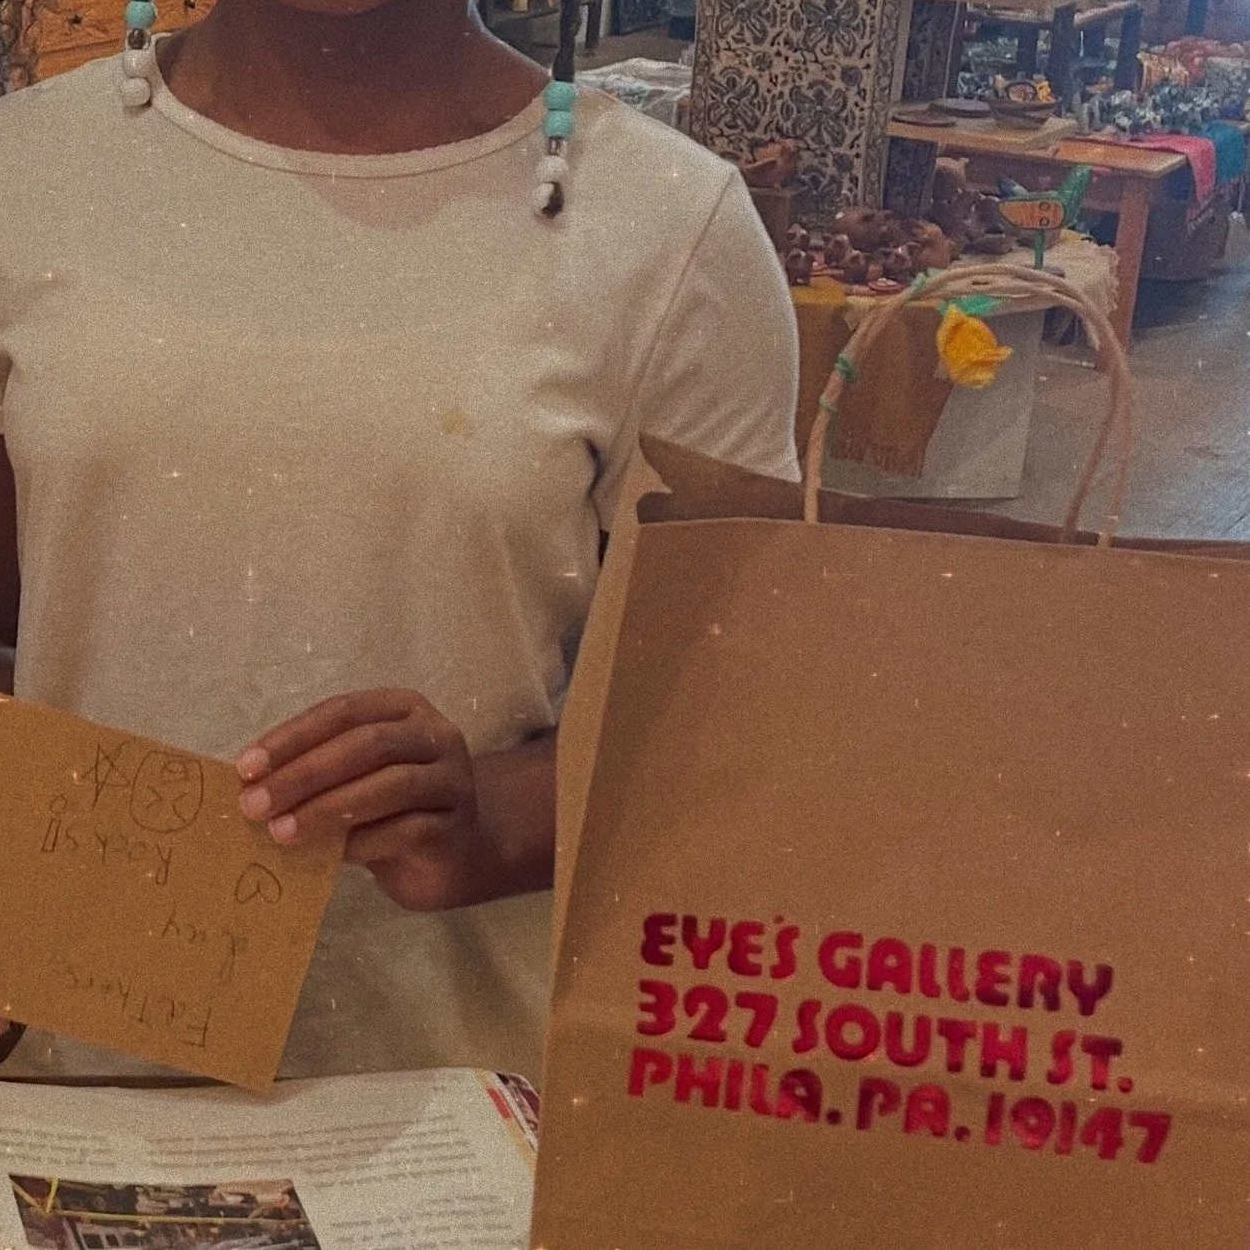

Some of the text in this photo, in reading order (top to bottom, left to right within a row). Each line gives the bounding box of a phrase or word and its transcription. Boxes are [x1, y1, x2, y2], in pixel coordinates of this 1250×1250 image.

[640, 912, 1113, 1017] EYE'S GALLERY
[636, 979, 1133, 1095] 327 SOUTH ST.
[627, 1047, 1173, 1164] PHILA. PA. 19147
